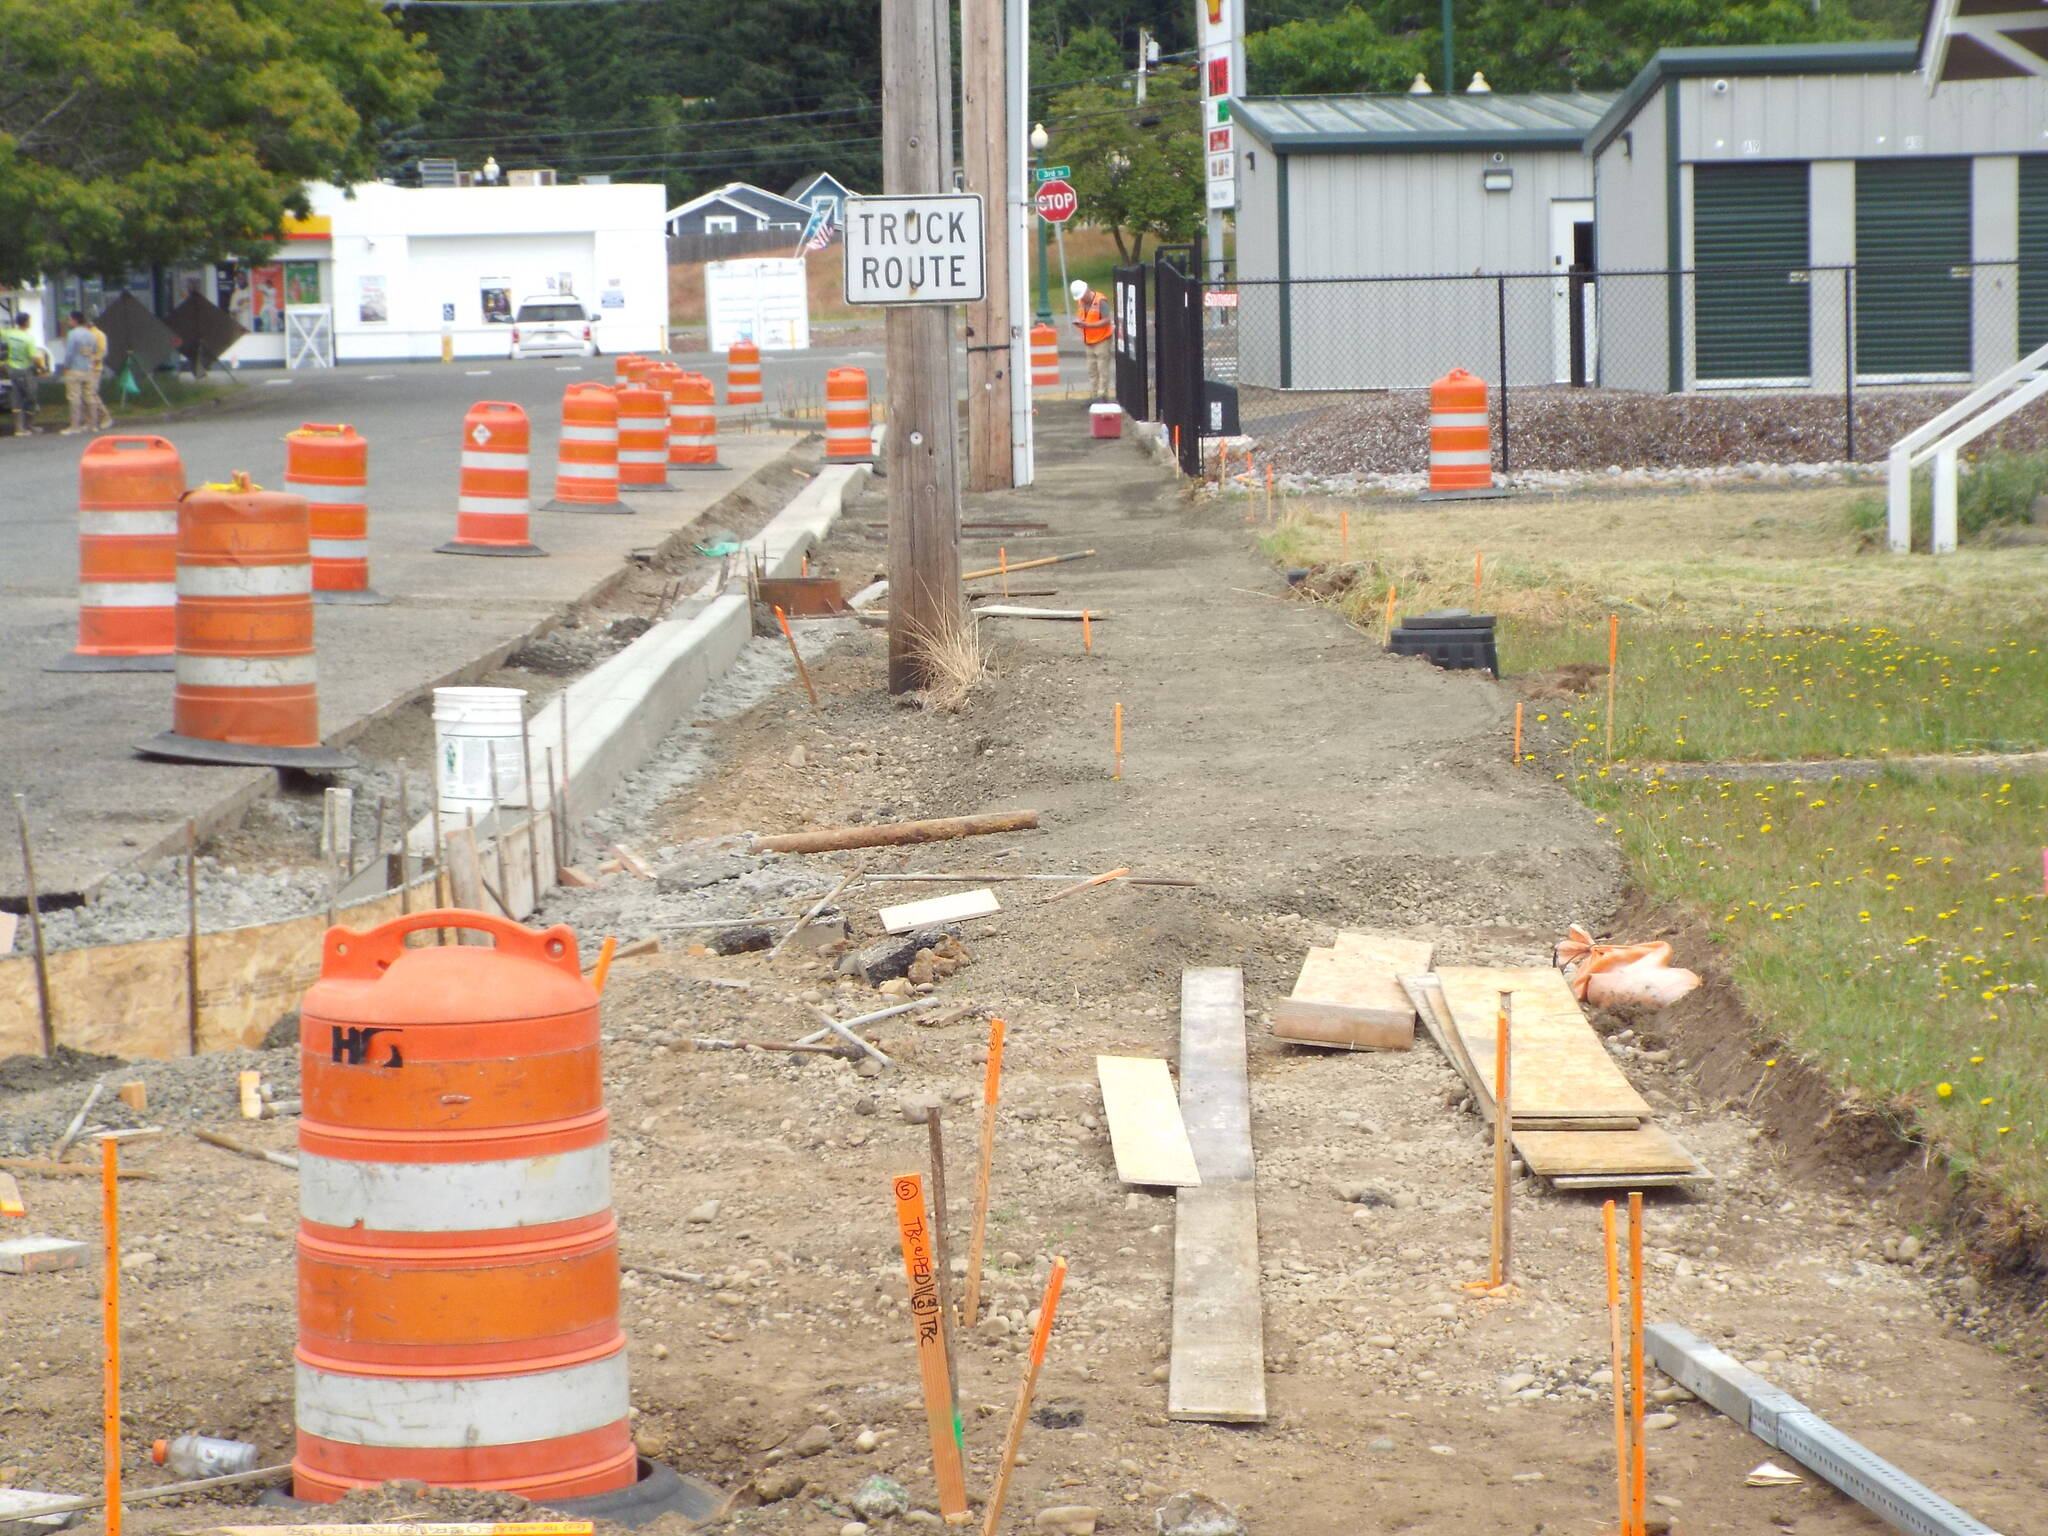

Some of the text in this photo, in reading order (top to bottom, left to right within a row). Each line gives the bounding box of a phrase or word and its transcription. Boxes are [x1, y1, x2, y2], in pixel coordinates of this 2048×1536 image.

[1038, 193, 1073, 211] STOP
[859, 211, 966, 245] TRUCK
[862, 255, 966, 289] ROUTE
